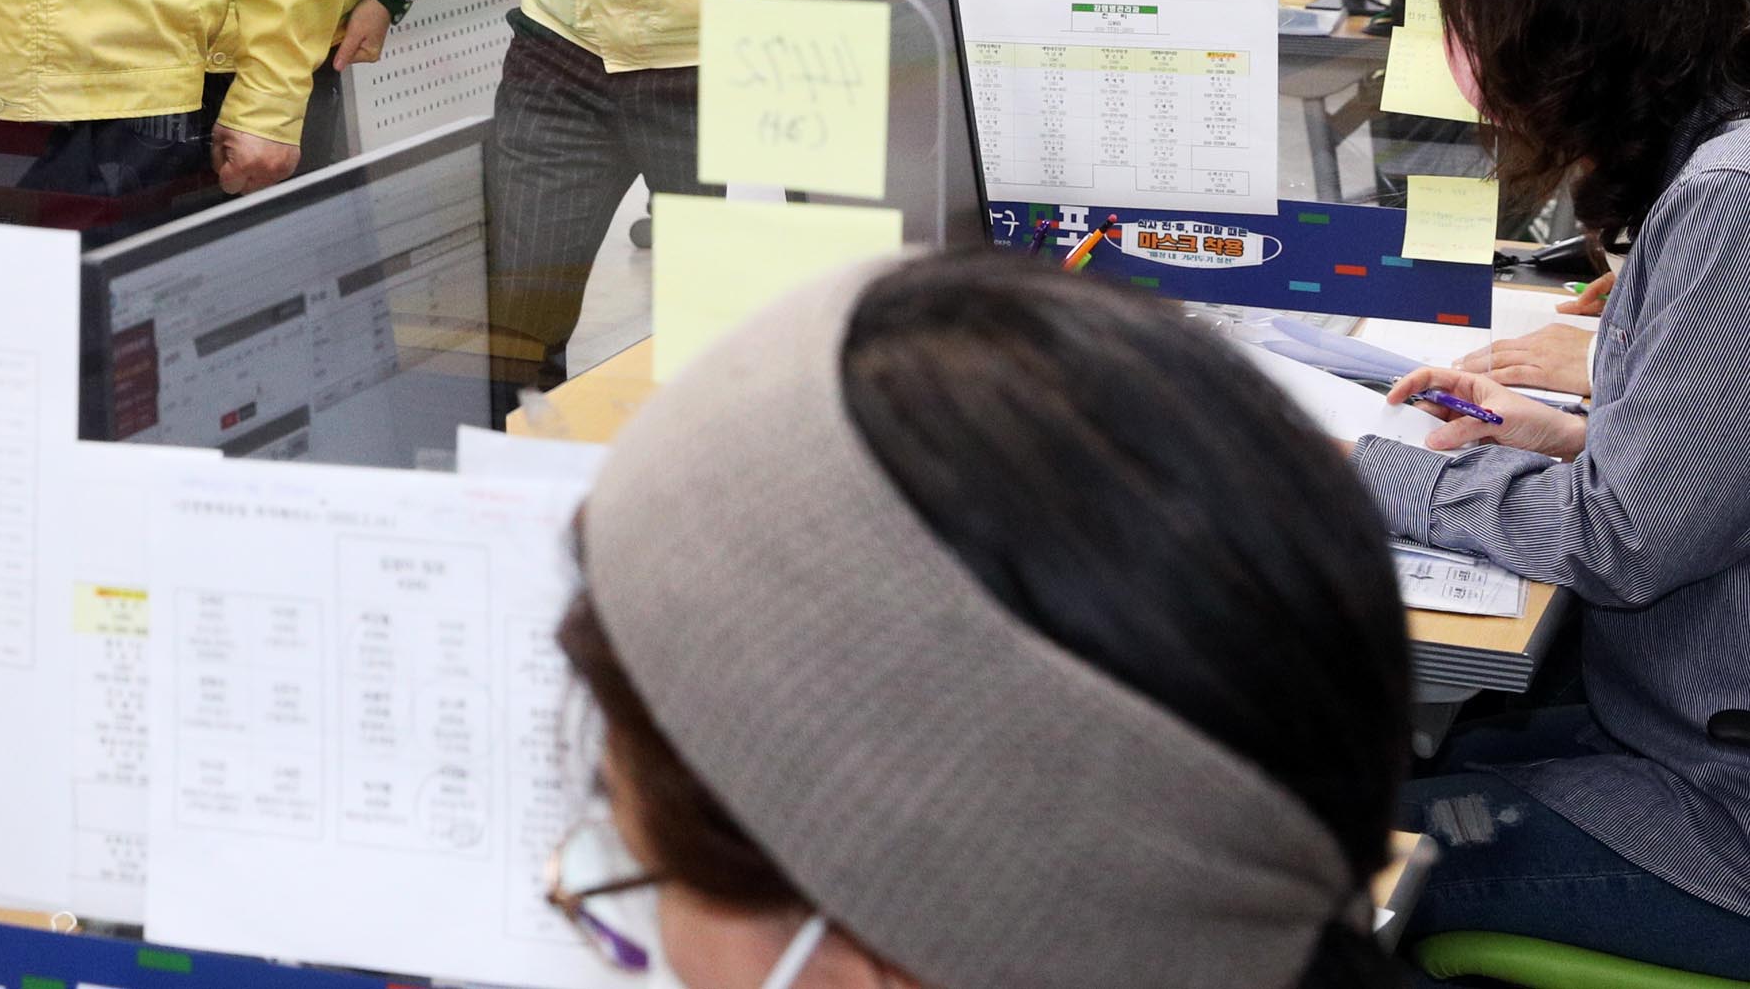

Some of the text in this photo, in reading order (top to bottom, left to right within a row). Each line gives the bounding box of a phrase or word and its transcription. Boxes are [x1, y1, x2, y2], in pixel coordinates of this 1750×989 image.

[1137, 218, 1158, 230] 식사
[1137, 230, 1245, 257] 마스크 착용
